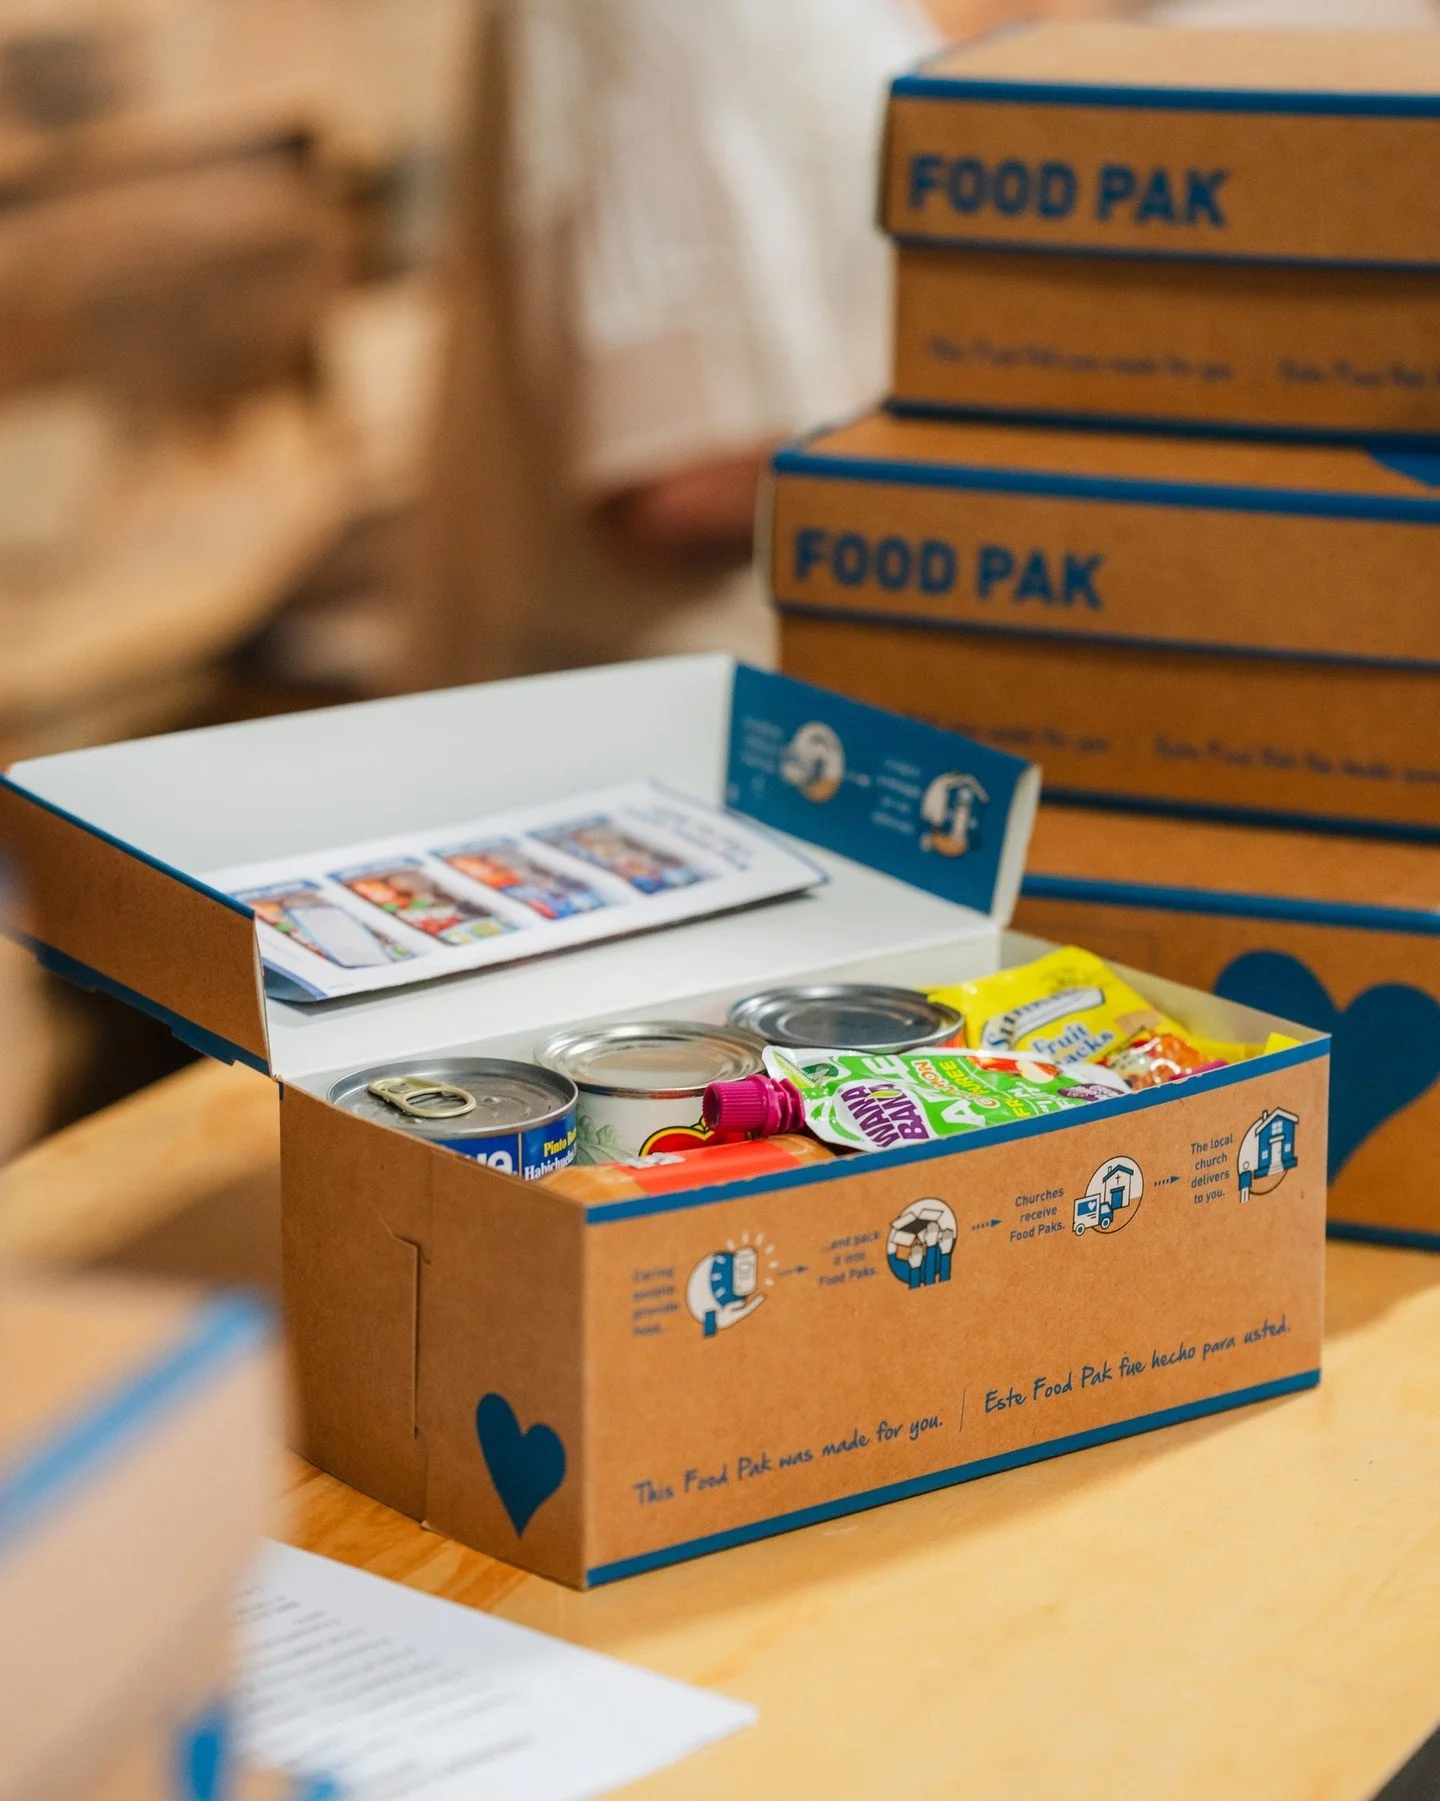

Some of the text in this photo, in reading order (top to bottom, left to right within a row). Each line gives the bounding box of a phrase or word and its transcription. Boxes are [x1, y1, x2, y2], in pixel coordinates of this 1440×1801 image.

[909, 155, 1230, 228] FOOD PAK
[792, 527, 1106, 609] FOOD PAK
[544, 1139, 567, 1157] Pinto
[1191, 1134, 1233, 1154] The local
[1195, 1153, 1228, 1170] church
[1191, 1170, 1230, 1188] delivers
[1015, 1188, 1064, 1207] Churches
[1194, 1190, 1225, 1204] to you.
[1020, 1207, 1057, 1222] receive
[1010, 1222, 1065, 1242] Food Paks.
[985, 1314, 1292, 1413] Este Food Pak fue hecho para usted.
[632, 1414, 944, 1505] This Food Pak was made for you.
